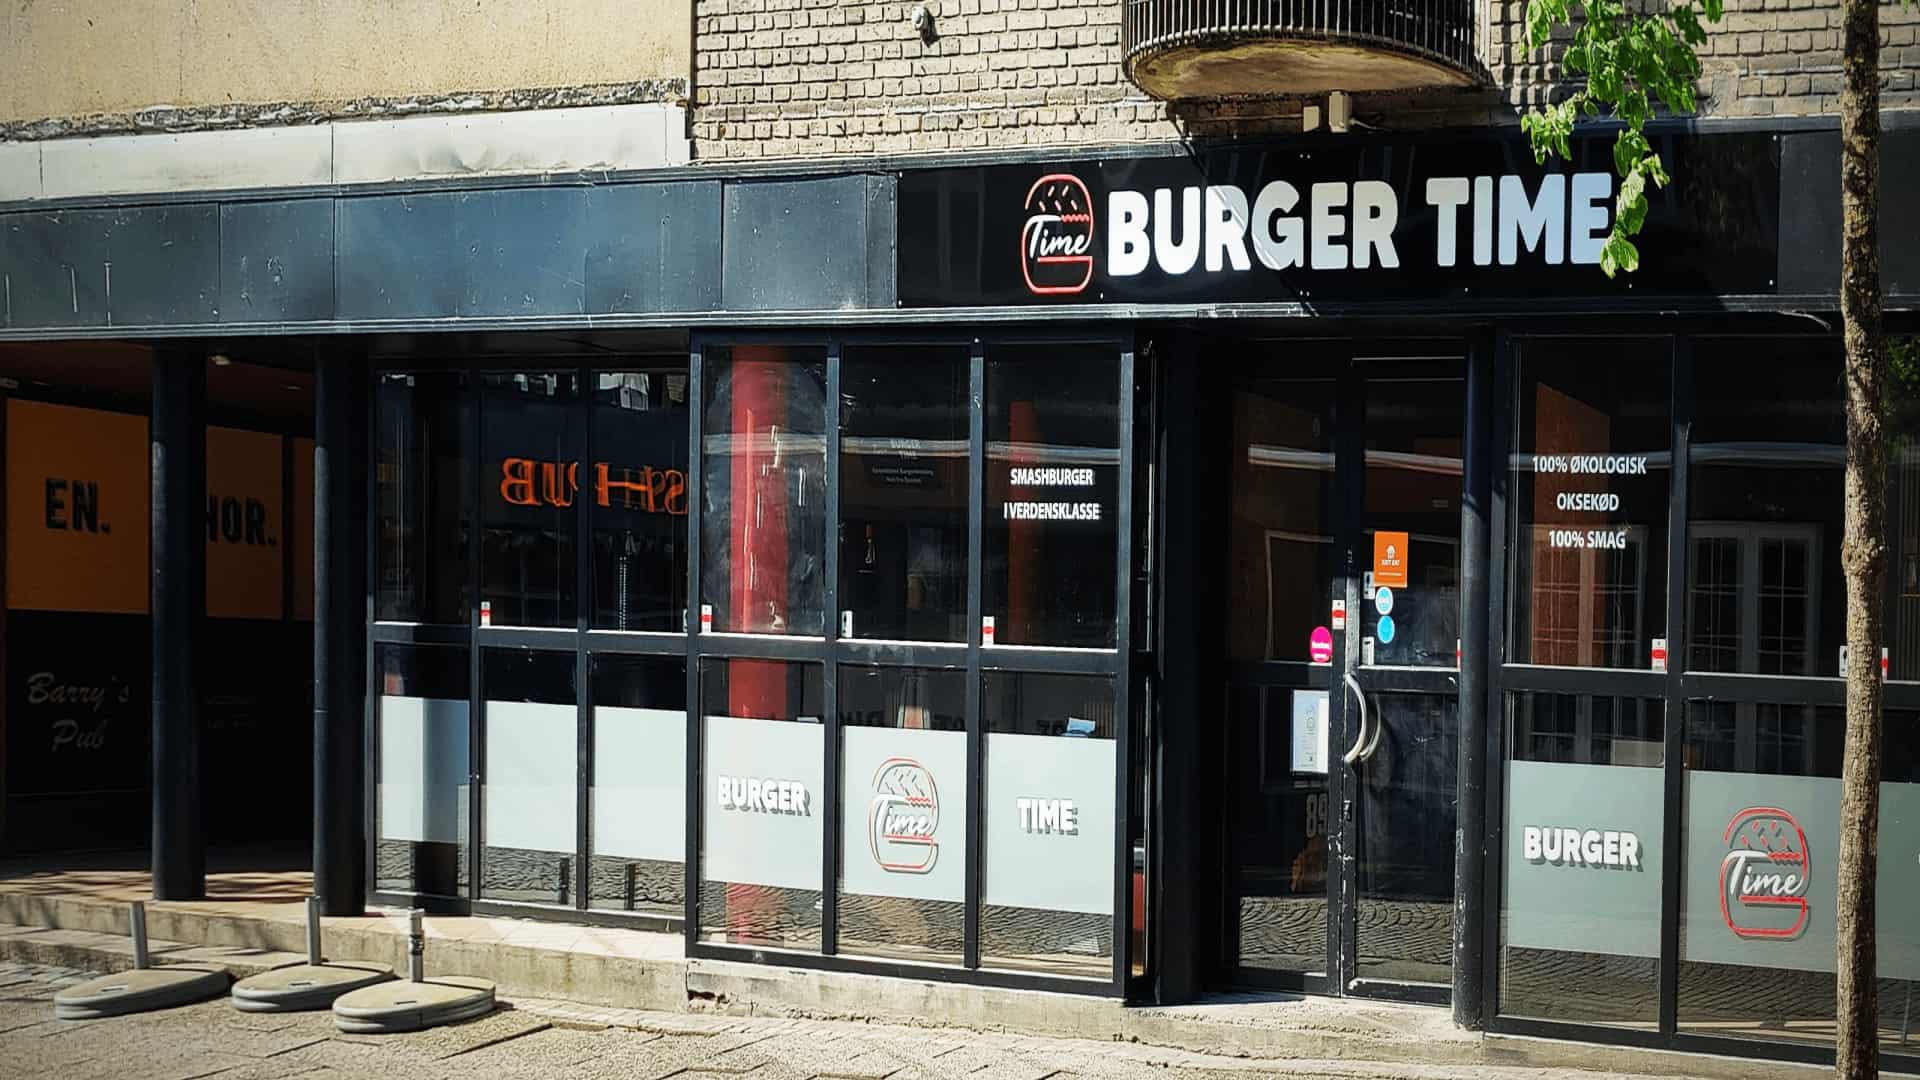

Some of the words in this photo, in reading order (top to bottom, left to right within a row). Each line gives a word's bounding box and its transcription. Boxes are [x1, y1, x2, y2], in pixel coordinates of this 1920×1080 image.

[1024, 214, 1086, 257] Time
[1107, 180, 1400, 276] BURGER
[1426, 171, 1612, 266] TIME
[1010, 467, 1094, 486] SMASHBURGER
[1532, 455, 1568, 473] 100%
[1570, 456, 1647, 475] ØKOLOGISK
[45, 477, 112, 534] EN.
[1003, 502, 1008, 519] I
[1009, 502, 1101, 520] VERDENSKLASSE
[1556, 492, 1620, 511] OKSEKØD
[1549, 530, 1584, 548] 100%
[1586, 531, 1626, 549] SMAG
[50, 719, 105, 752] Pub
[717, 775, 810, 815] BURGER
[872, 793, 934, 838] Time
[1017, 797, 1077, 833] TIME
[1523, 826, 1639, 867] BURGER
[1723, 850, 1803, 895] Time
